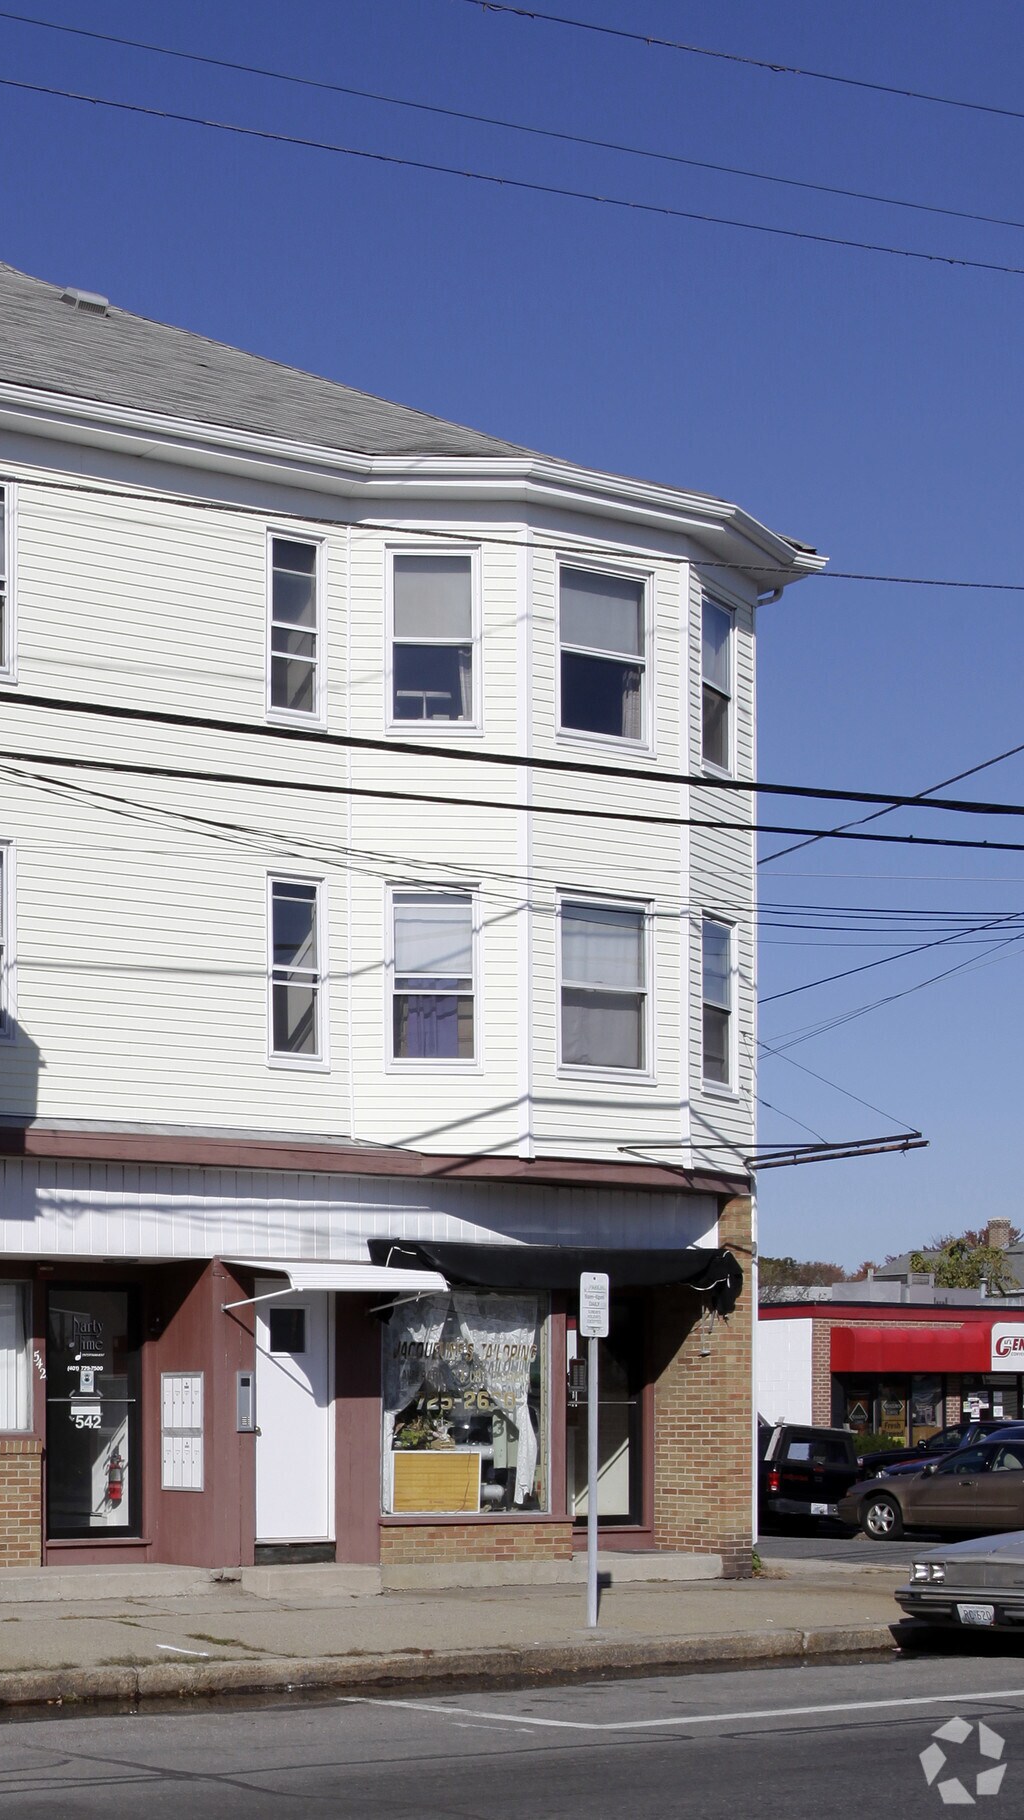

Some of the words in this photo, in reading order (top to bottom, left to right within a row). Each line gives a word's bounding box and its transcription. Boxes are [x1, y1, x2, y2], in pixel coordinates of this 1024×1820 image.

[481, 1343, 538, 1363] TAILORING
[33, 1350, 47, 1380] 542
[74, 1415, 102, 1429] 542
